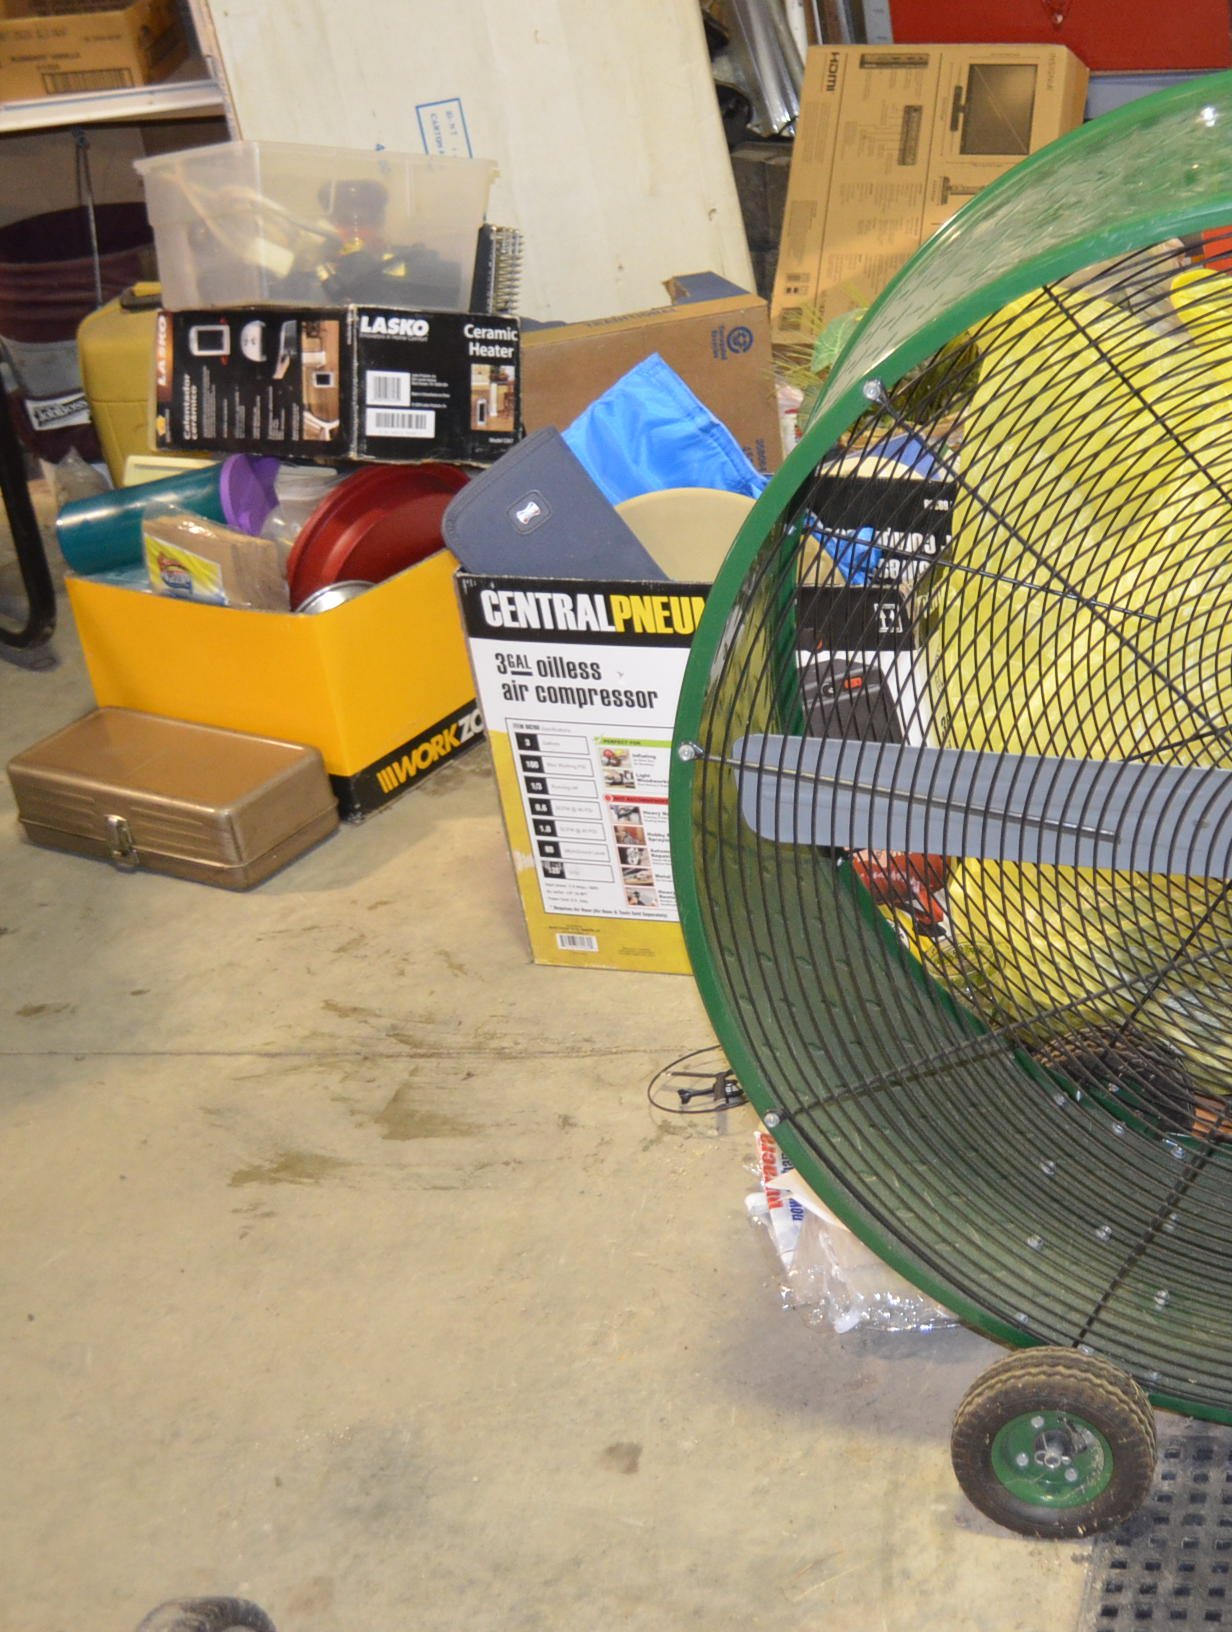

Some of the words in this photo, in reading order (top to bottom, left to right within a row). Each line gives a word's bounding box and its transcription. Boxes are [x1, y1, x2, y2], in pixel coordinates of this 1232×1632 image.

[359, 315, 430, 337] LASKO
[463, 323, 519, 341] Ceramic
[157, 313, 168, 387] LASKO
[468, 342, 515, 358] Heater
[508, 653, 532, 670] GAL
[536, 655, 602, 681] oilless
[502, 680, 529, 702] air
[535, 684, 659, 709] compressor
